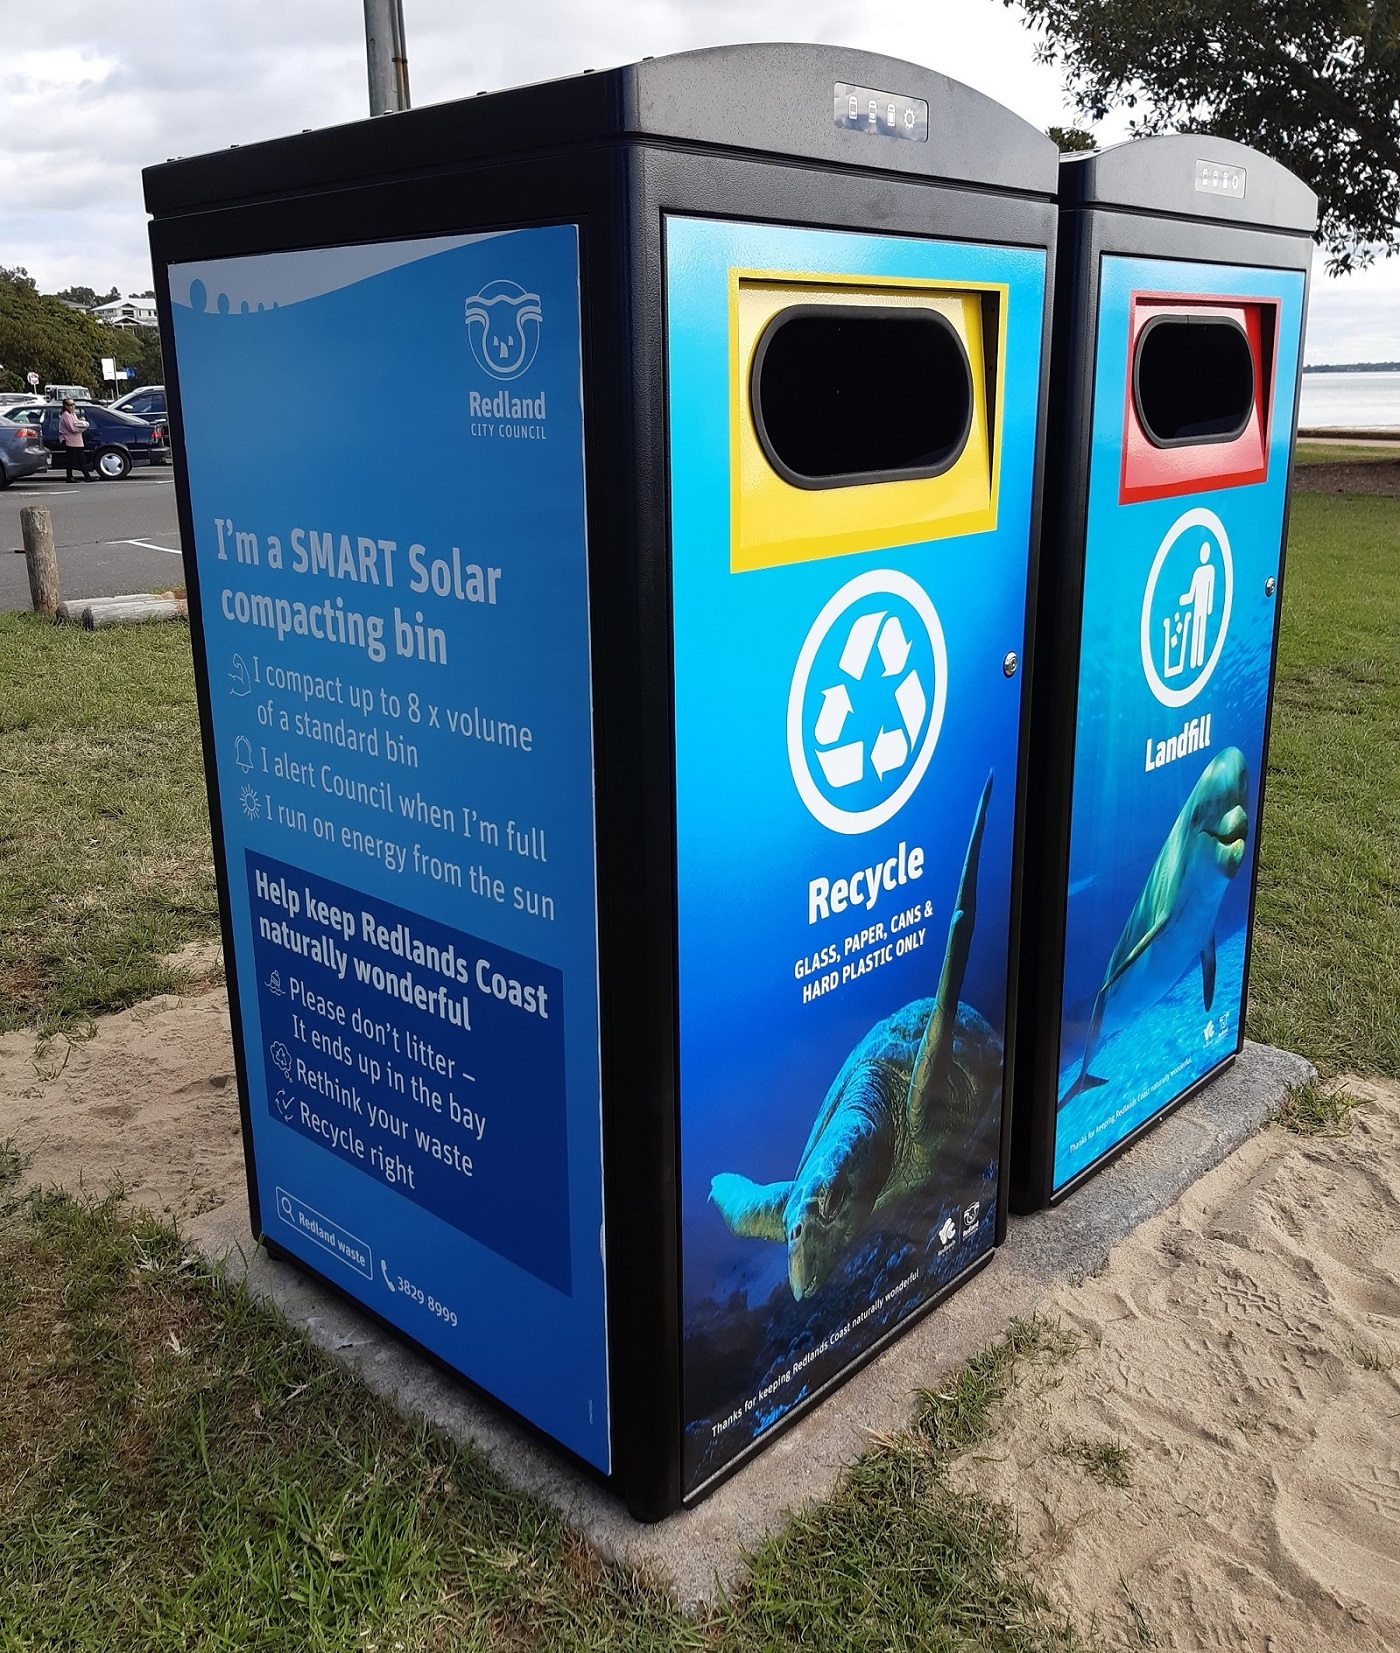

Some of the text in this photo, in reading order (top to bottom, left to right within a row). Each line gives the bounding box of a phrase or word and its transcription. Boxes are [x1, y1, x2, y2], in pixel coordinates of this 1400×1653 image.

[469, 391, 546, 419] Redland
[471, 423, 546, 439] CITY COUNCIL
[267, 536, 283, 569] a
[291, 528, 397, 587] SMART
[409, 544, 502, 604] Solar
[221, 589, 447, 665] compacting bin
[253, 656, 532, 751] I compact up to 8 x volume
[258, 700, 418, 768] of a standard bin
[1145, 713, 1212, 773] Landfill
[261, 747, 268, 772] I
[275, 752, 315, 788] alert
[321, 765, 393, 812] Council
[399, 792, 454, 832] when
[507, 820, 547, 862] full
[265, 795, 554, 921] I run on energy from the sun
[808, 841, 924, 925] Recycle
[256, 869, 548, 1019] Help keep Redlands Coast
[260, 917, 471, 1031] naturally wonderful
[795, 900, 934, 979] GLASS, PAPER, CANS &
[803, 928, 926, 1004] HARD PLASTIC ONLY
[290, 977, 345, 1025] Please
[406, 1031, 455, 1078] litter
[292, 1014, 485, 1140] It ends up in the bay
[297, 1058, 472, 1176] Rethink your waste
[300, 1101, 415, 1189] Recycle right
[299, 1211, 365, 1267] Redland waste
[397, 1276, 457, 1327] 3829 8999
[711, 1268, 919, 1437] Thanks for keeping Redlands Coast naturally wonderful
